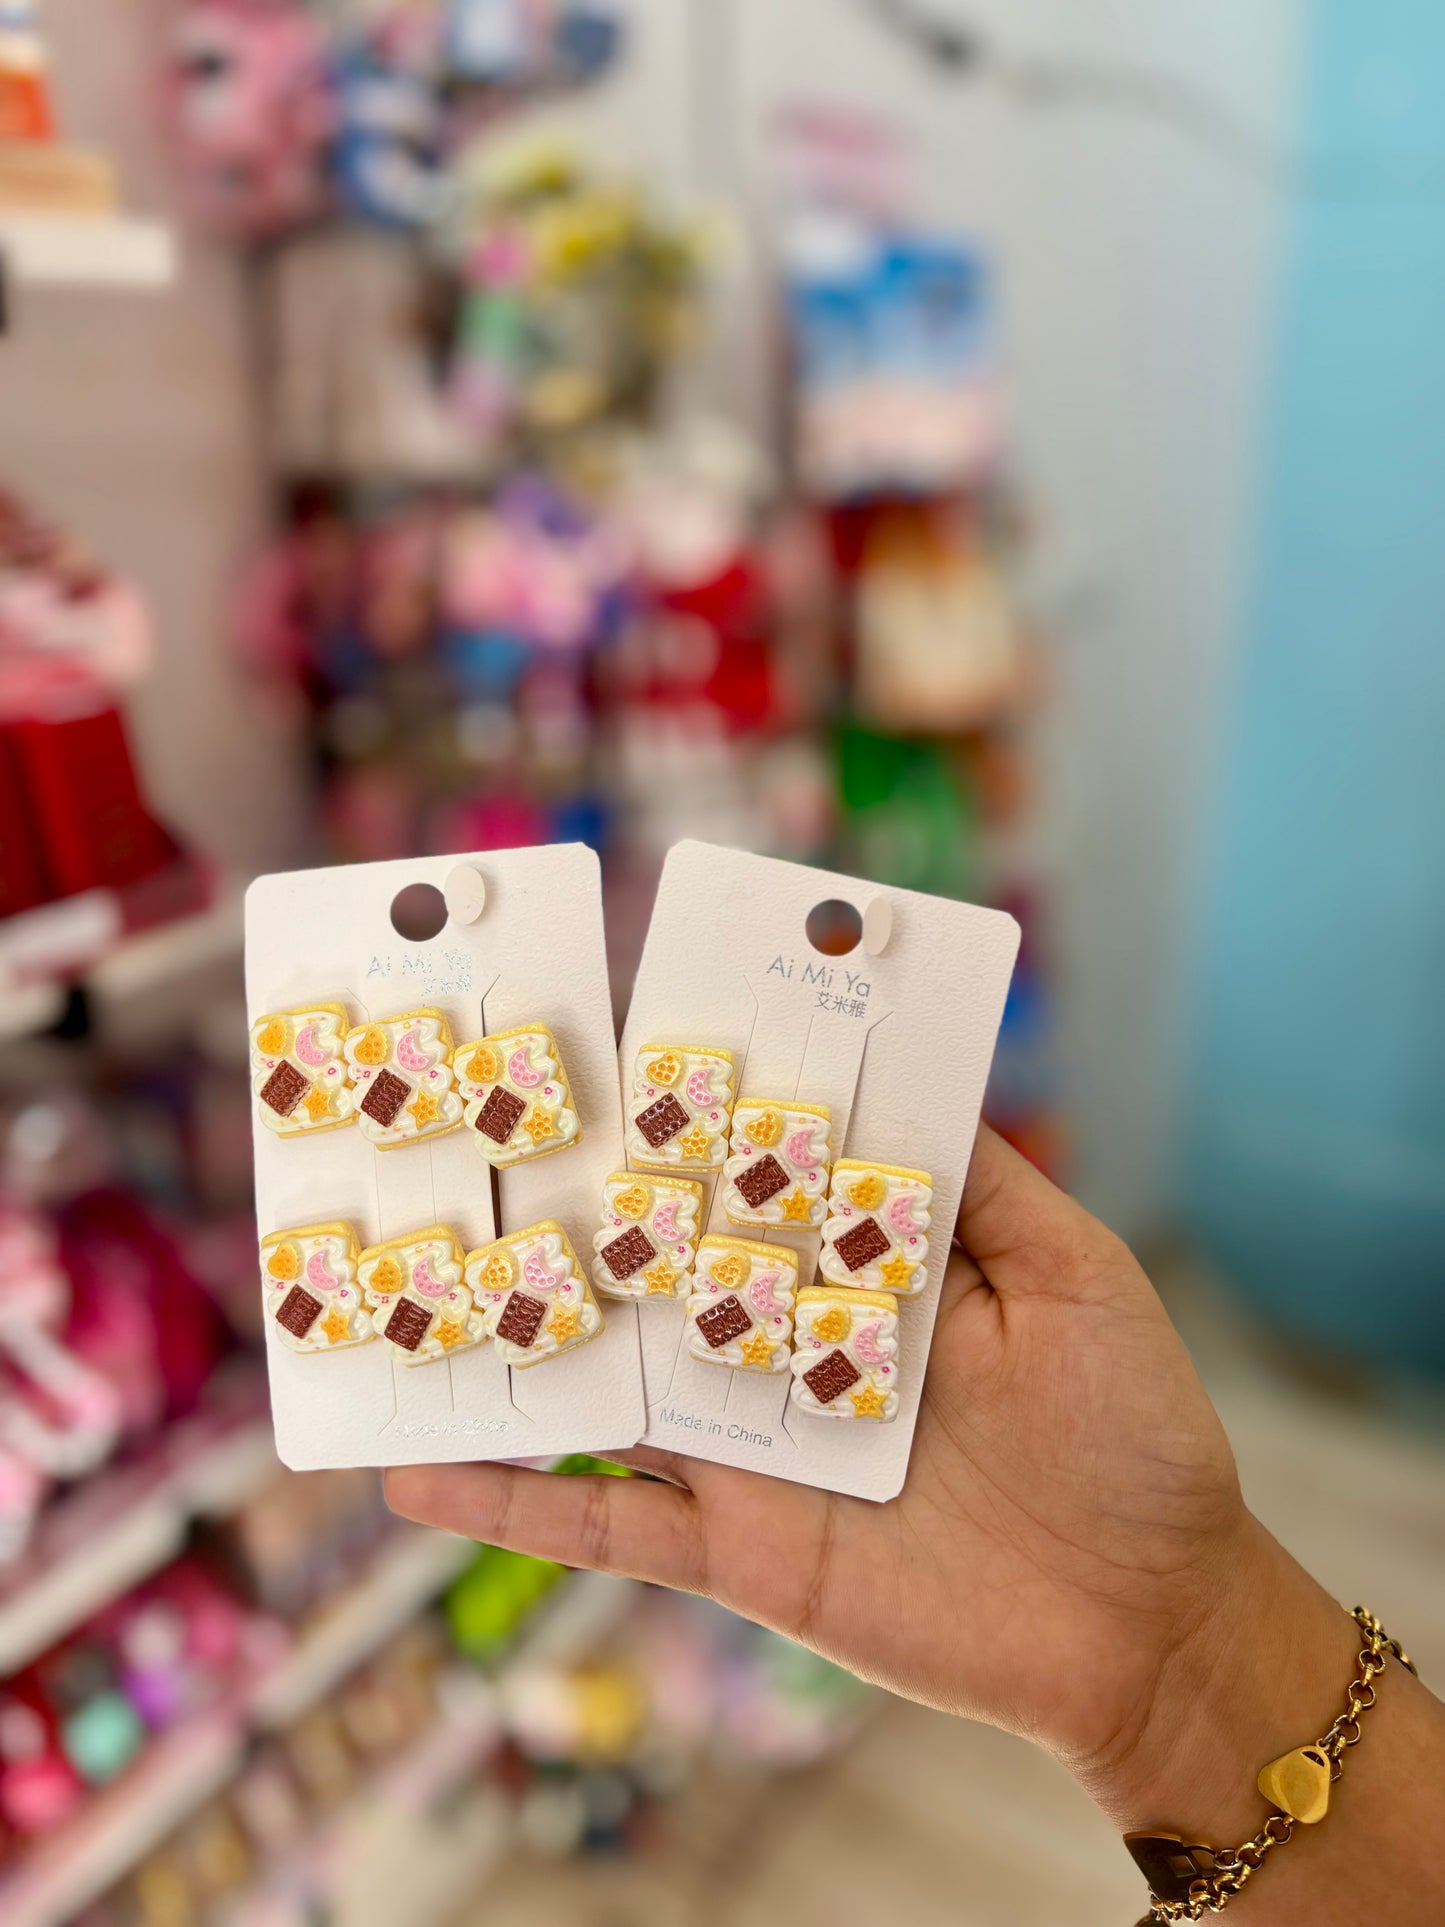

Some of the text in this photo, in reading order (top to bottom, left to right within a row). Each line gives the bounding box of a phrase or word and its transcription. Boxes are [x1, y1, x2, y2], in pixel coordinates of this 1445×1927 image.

[766, 954, 871, 998] Ai Mi Ya
[814, 991, 867, 1018] 艾米雅
[661, 1408, 772, 1447] Made in China
